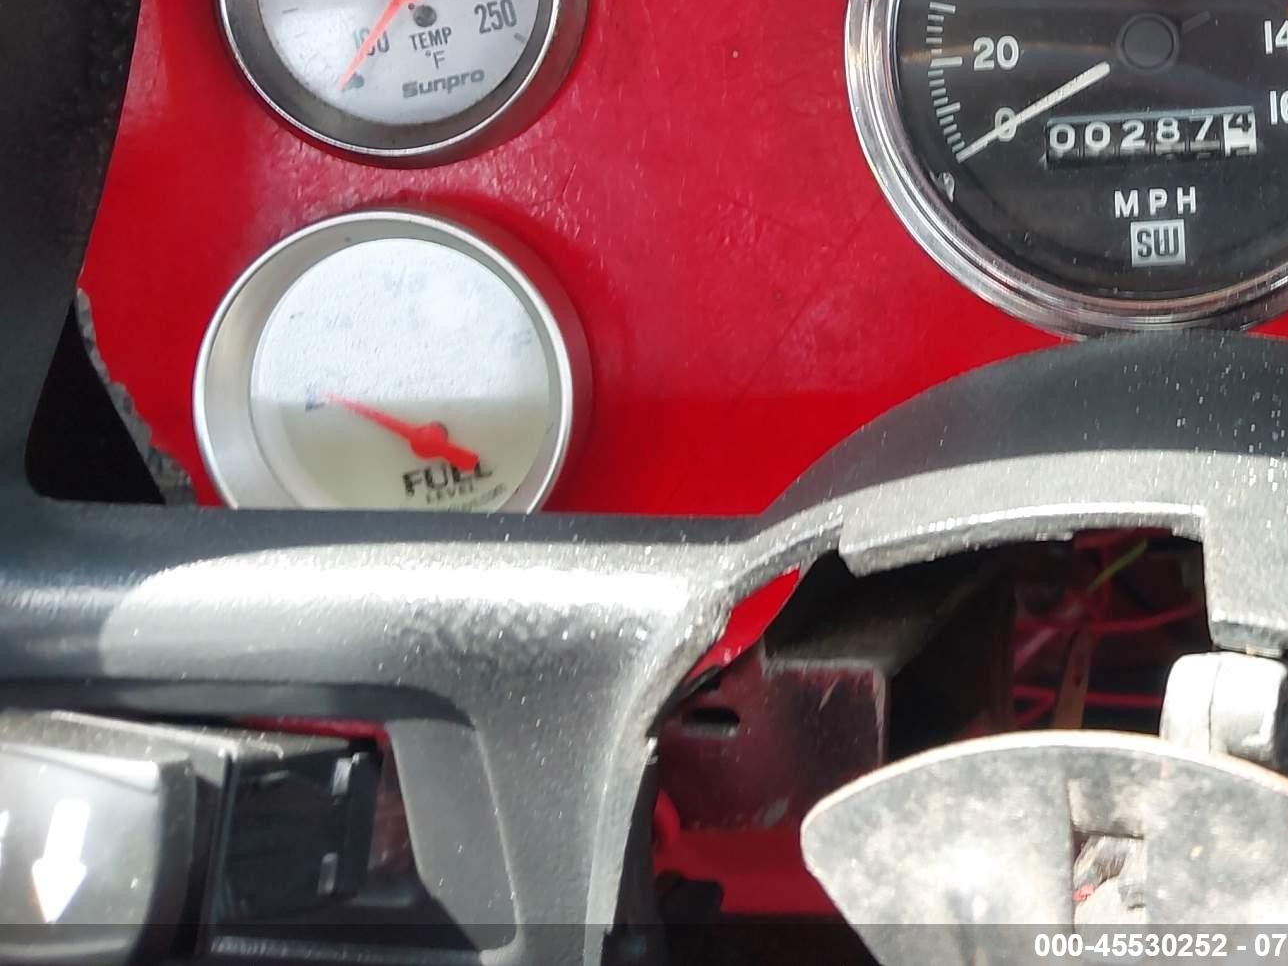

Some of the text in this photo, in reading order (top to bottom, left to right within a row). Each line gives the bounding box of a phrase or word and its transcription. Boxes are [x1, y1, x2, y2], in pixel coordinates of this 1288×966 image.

[409, 26, 452, 51] TEMP
[972, 35, 1020, 71] 20
[402, 69, 485, 98] Sunpro
[994, 106, 1017, 141] 0
[1114, 185, 1197, 219] MPH
[1136, 226, 1180, 259] SW
